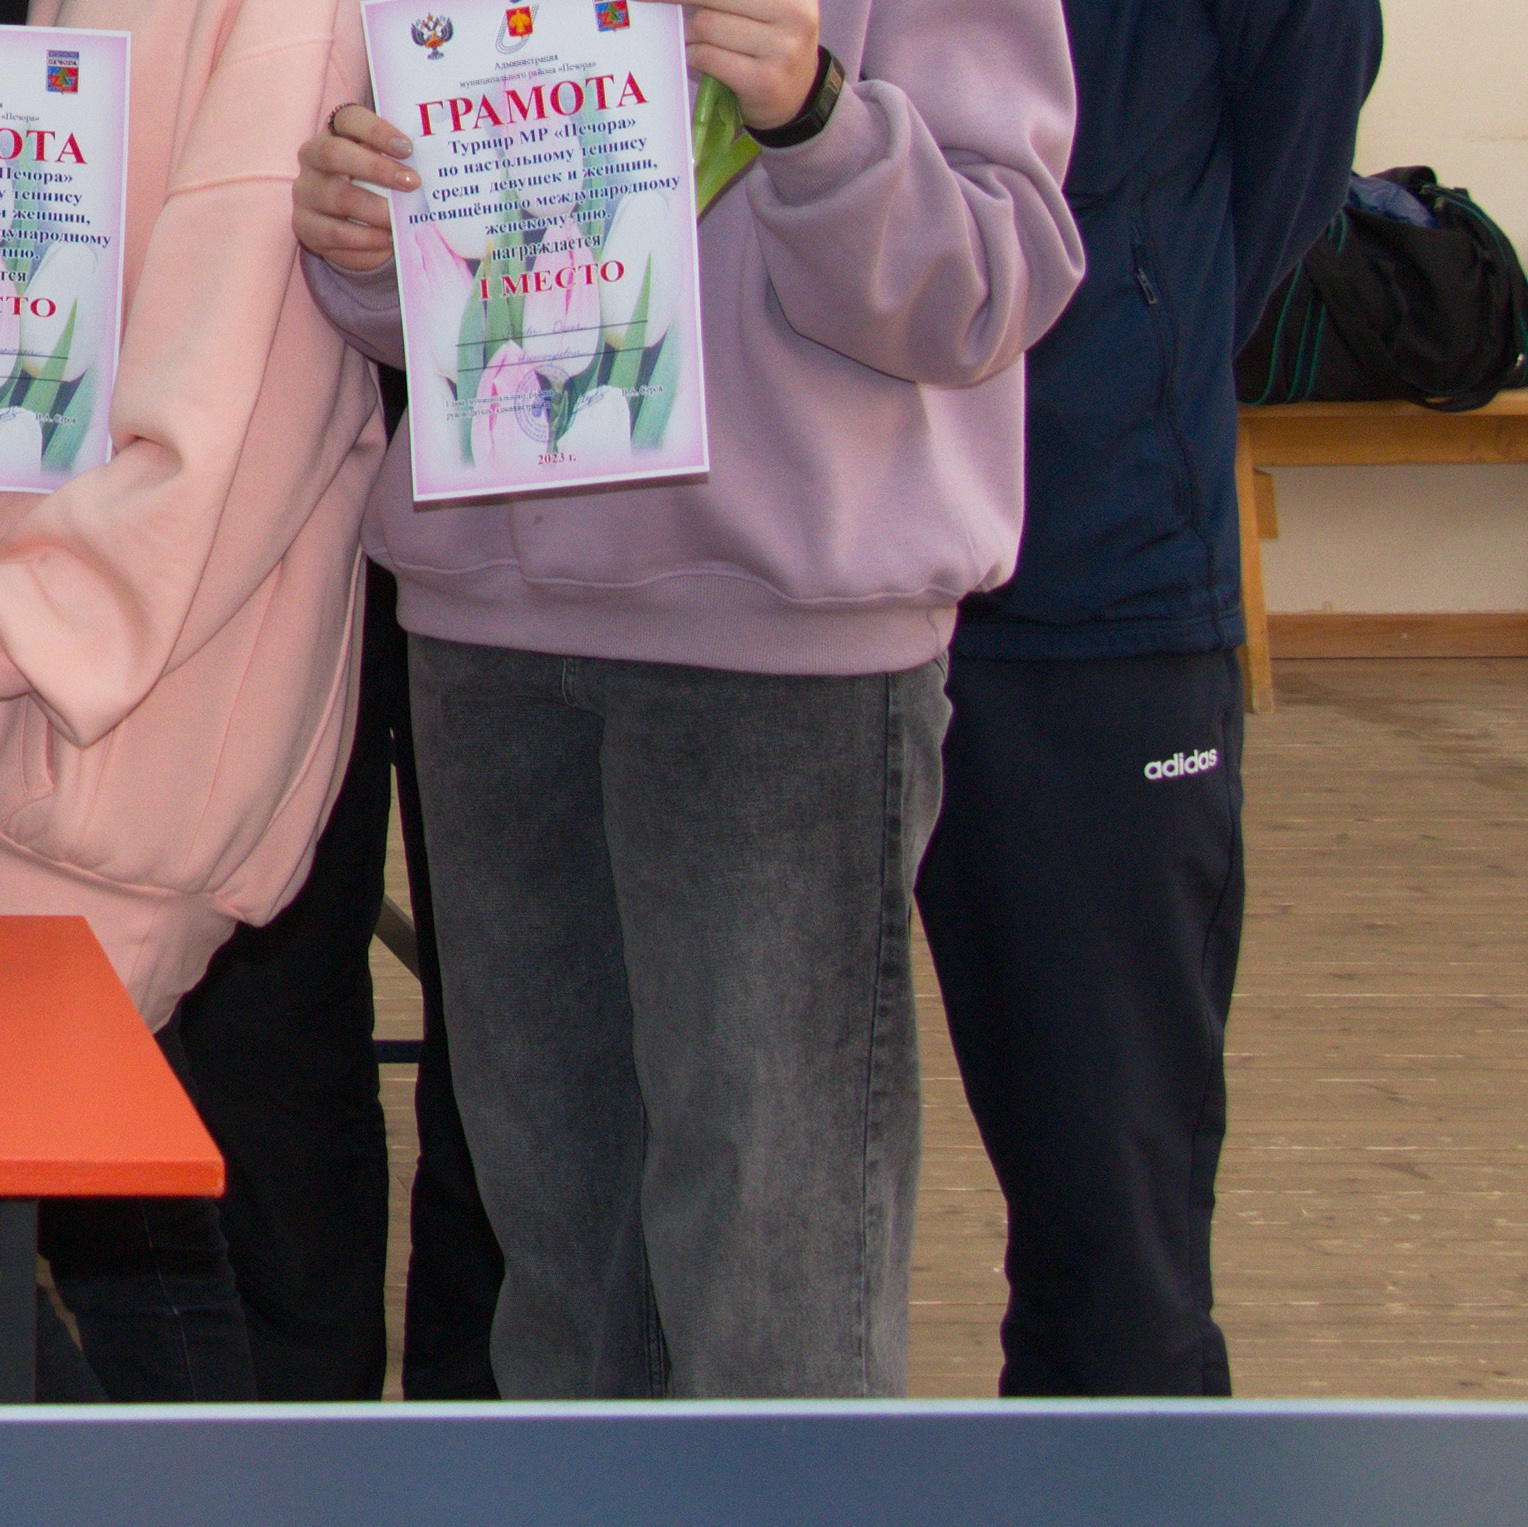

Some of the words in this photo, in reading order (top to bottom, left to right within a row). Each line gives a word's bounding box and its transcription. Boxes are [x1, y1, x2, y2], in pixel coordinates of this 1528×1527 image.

[416, 71, 649, 137] ГРАМОТА
[448, 135, 514, 155] Турнир
[519, 127, 549, 144] МР
[554, 118, 636, 137] «Печора»
[438, 164, 458, 178] по
[463, 147, 574, 174] настольному
[578, 137, 648, 157] теннису
[432, 182, 480, 201] среди
[489, 171, 562, 193] девушек
[567, 169, 577, 181] и
[582, 159, 658, 181] женщин,
[11, 189, 82, 207] теннису
[408, 199, 531, 227] посвящённого
[535, 176, 681, 206] международному
[12, 209, 90, 227] женщин,
[485, 213, 566, 235] женскому
[569, 209, 611, 225] дню.
[491, 234, 601, 260] награждается
[479, 277, 492, 300] I
[501, 260, 625, 297] МЕСТО
[537, 452, 566, 465] 2023
[1144, 749, 1218, 780] adidas
